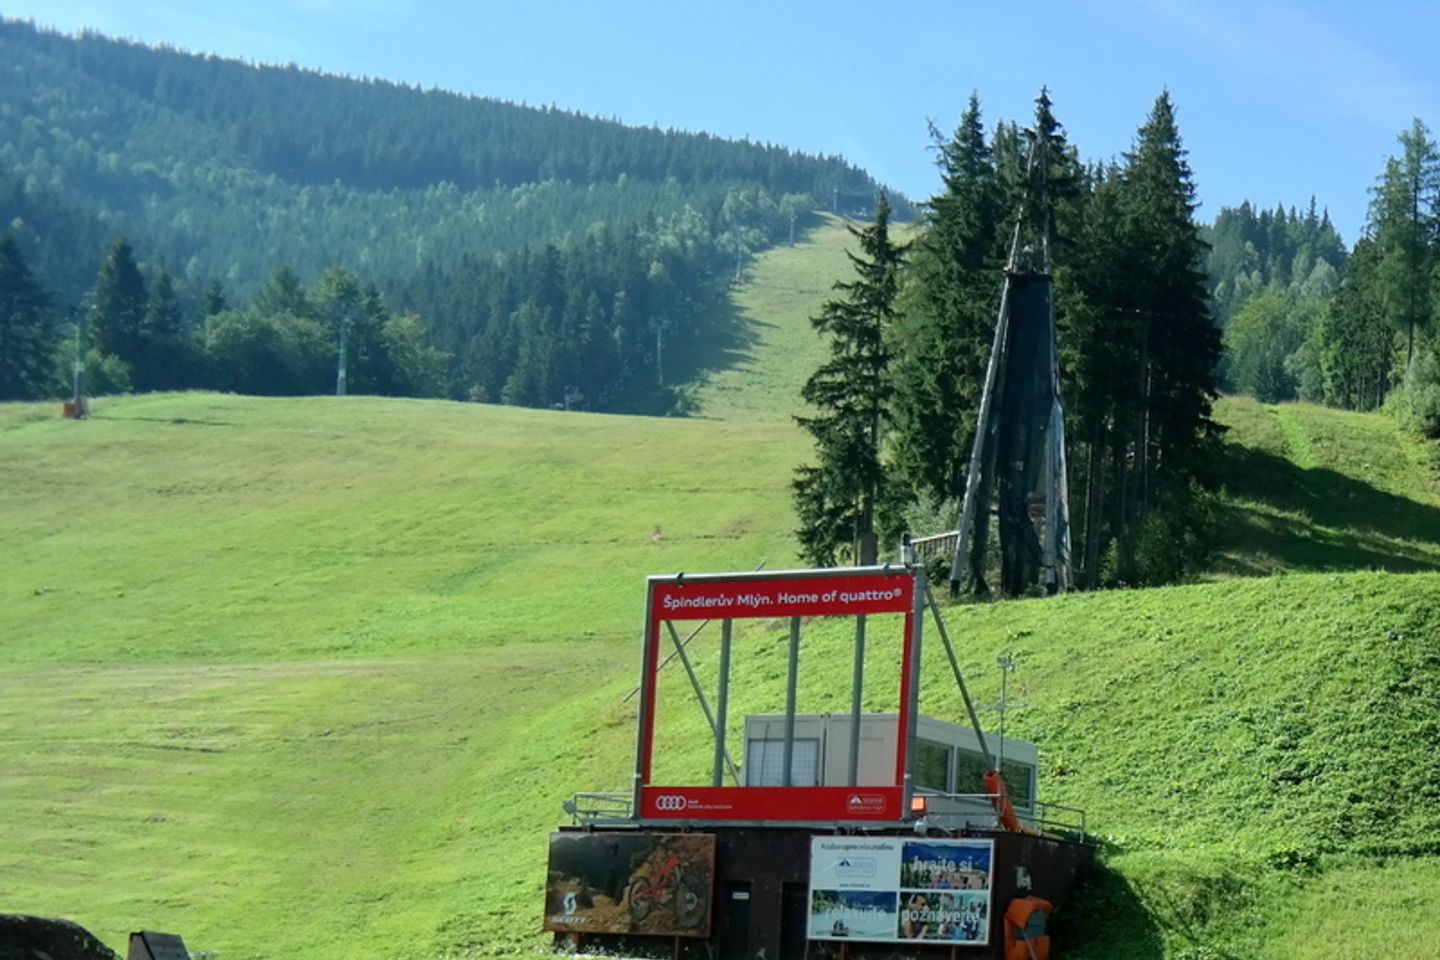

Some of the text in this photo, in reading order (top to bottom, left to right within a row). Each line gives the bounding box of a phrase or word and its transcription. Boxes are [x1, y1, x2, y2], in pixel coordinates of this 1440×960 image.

[664, 593, 733, 610] Špindlerův
[737, 594, 774, 608] Mlýn.
[778, 592, 818, 604] Home
[822, 590, 837, 602] of
[913, 856, 973, 875] hrajte si
